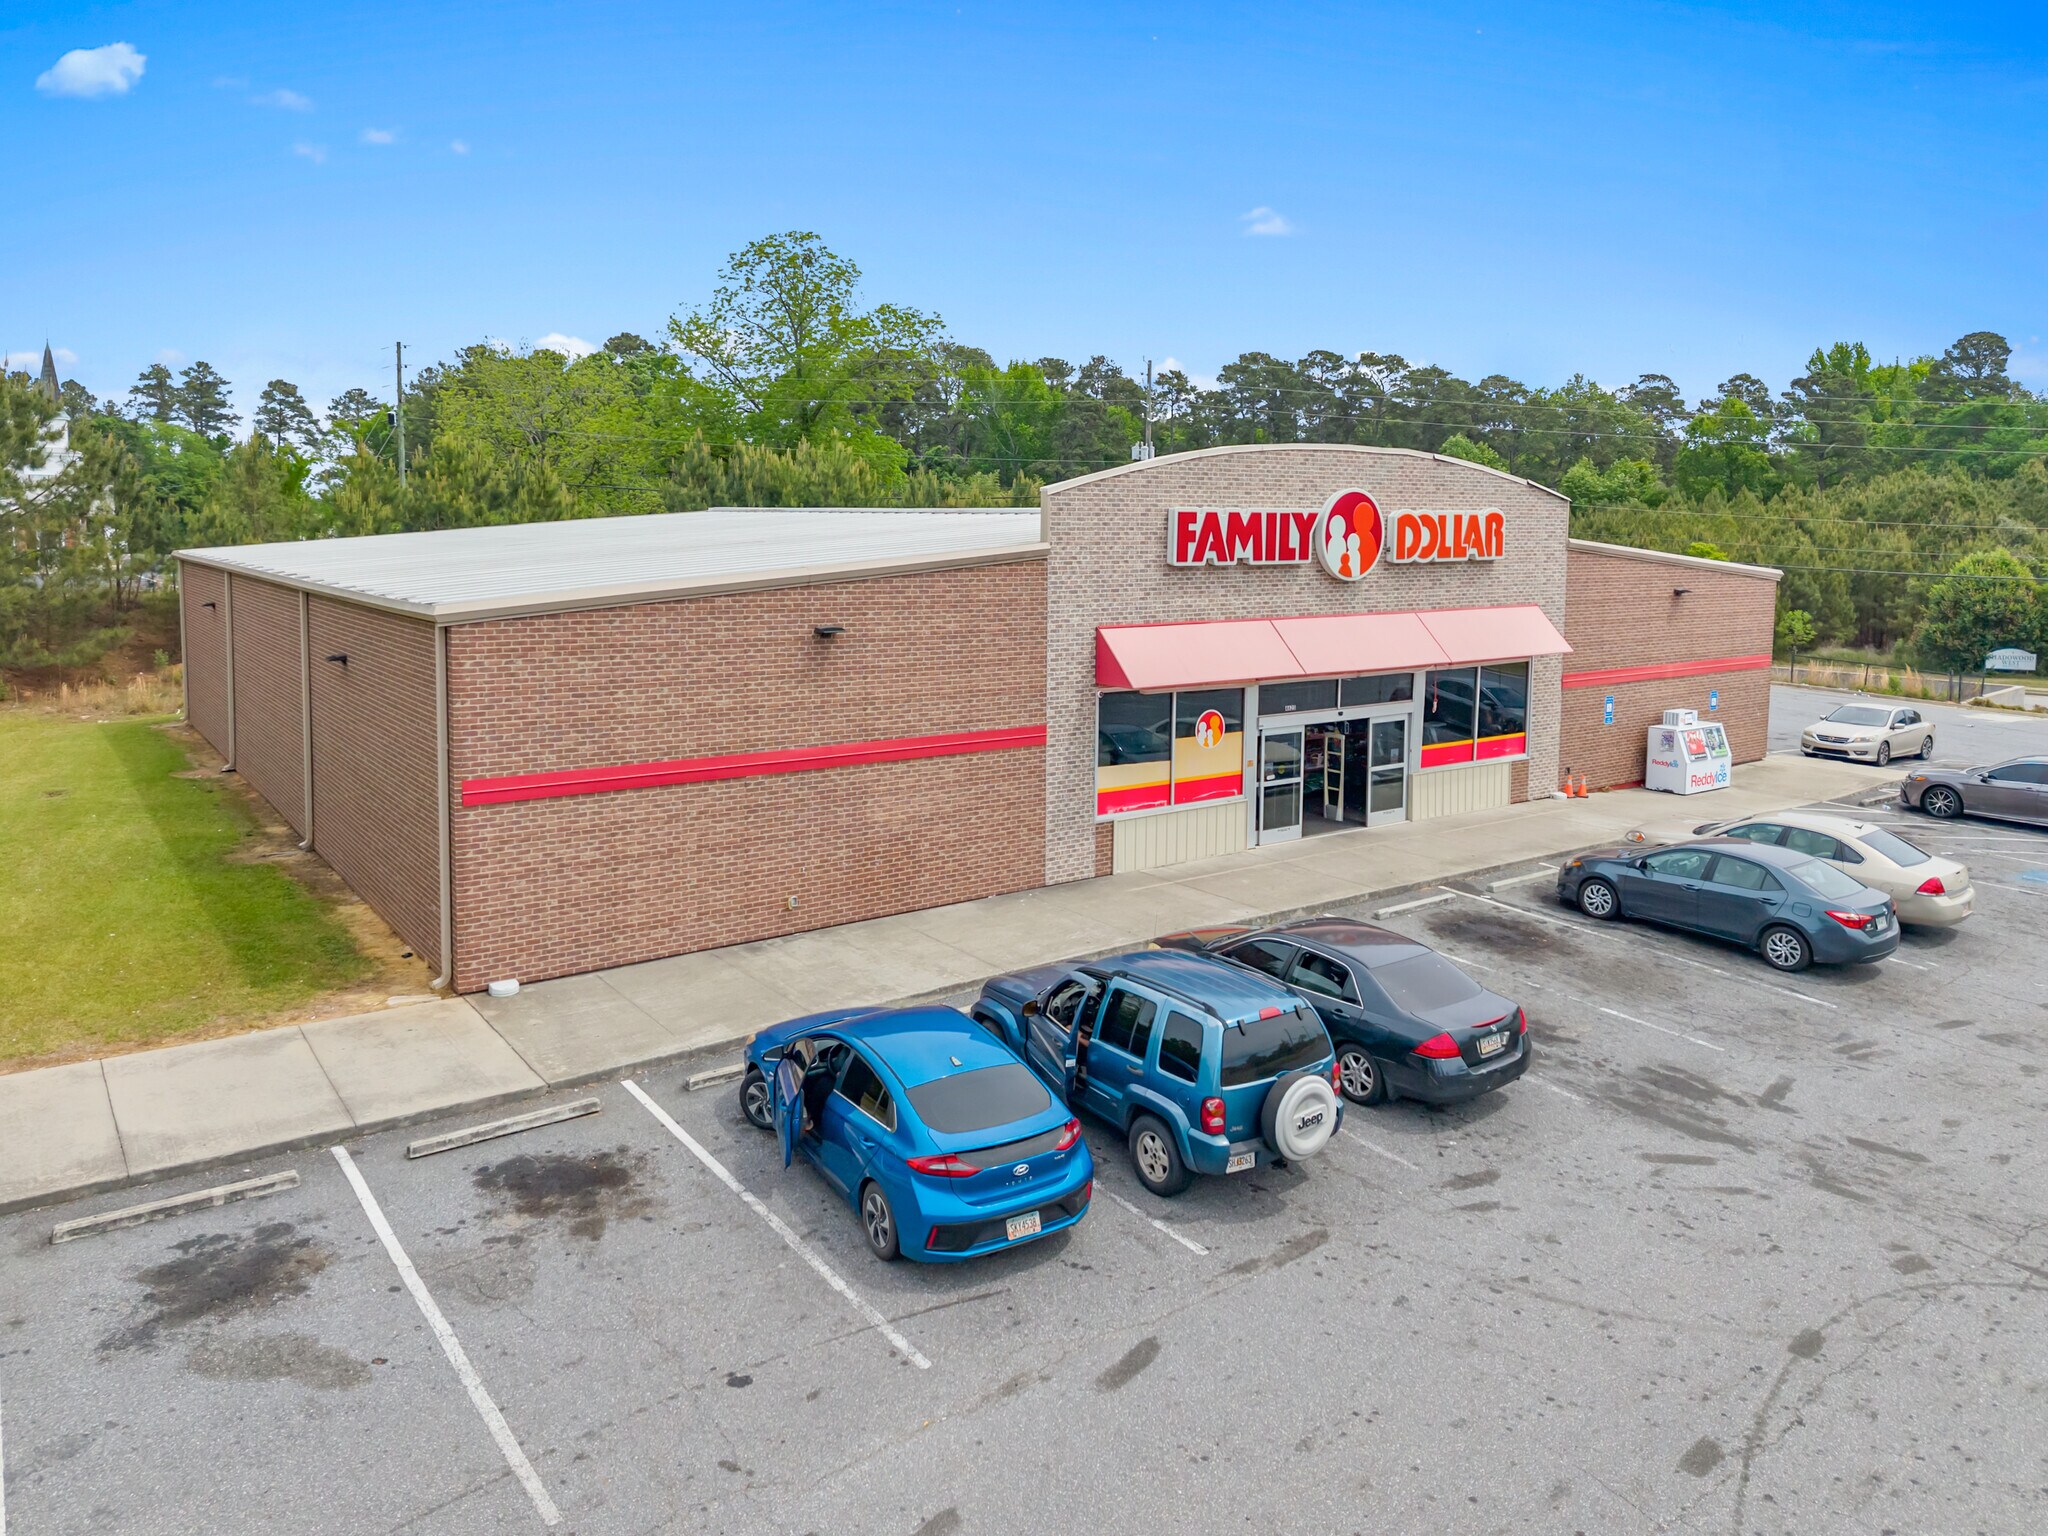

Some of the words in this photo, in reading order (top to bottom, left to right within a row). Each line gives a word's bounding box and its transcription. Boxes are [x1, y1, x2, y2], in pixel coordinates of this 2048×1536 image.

[1176, 511, 1318, 563] FAMILY
[1396, 511, 1504, 560] DOLLAR
[1298, 1112, 1323, 1129] Jeep
